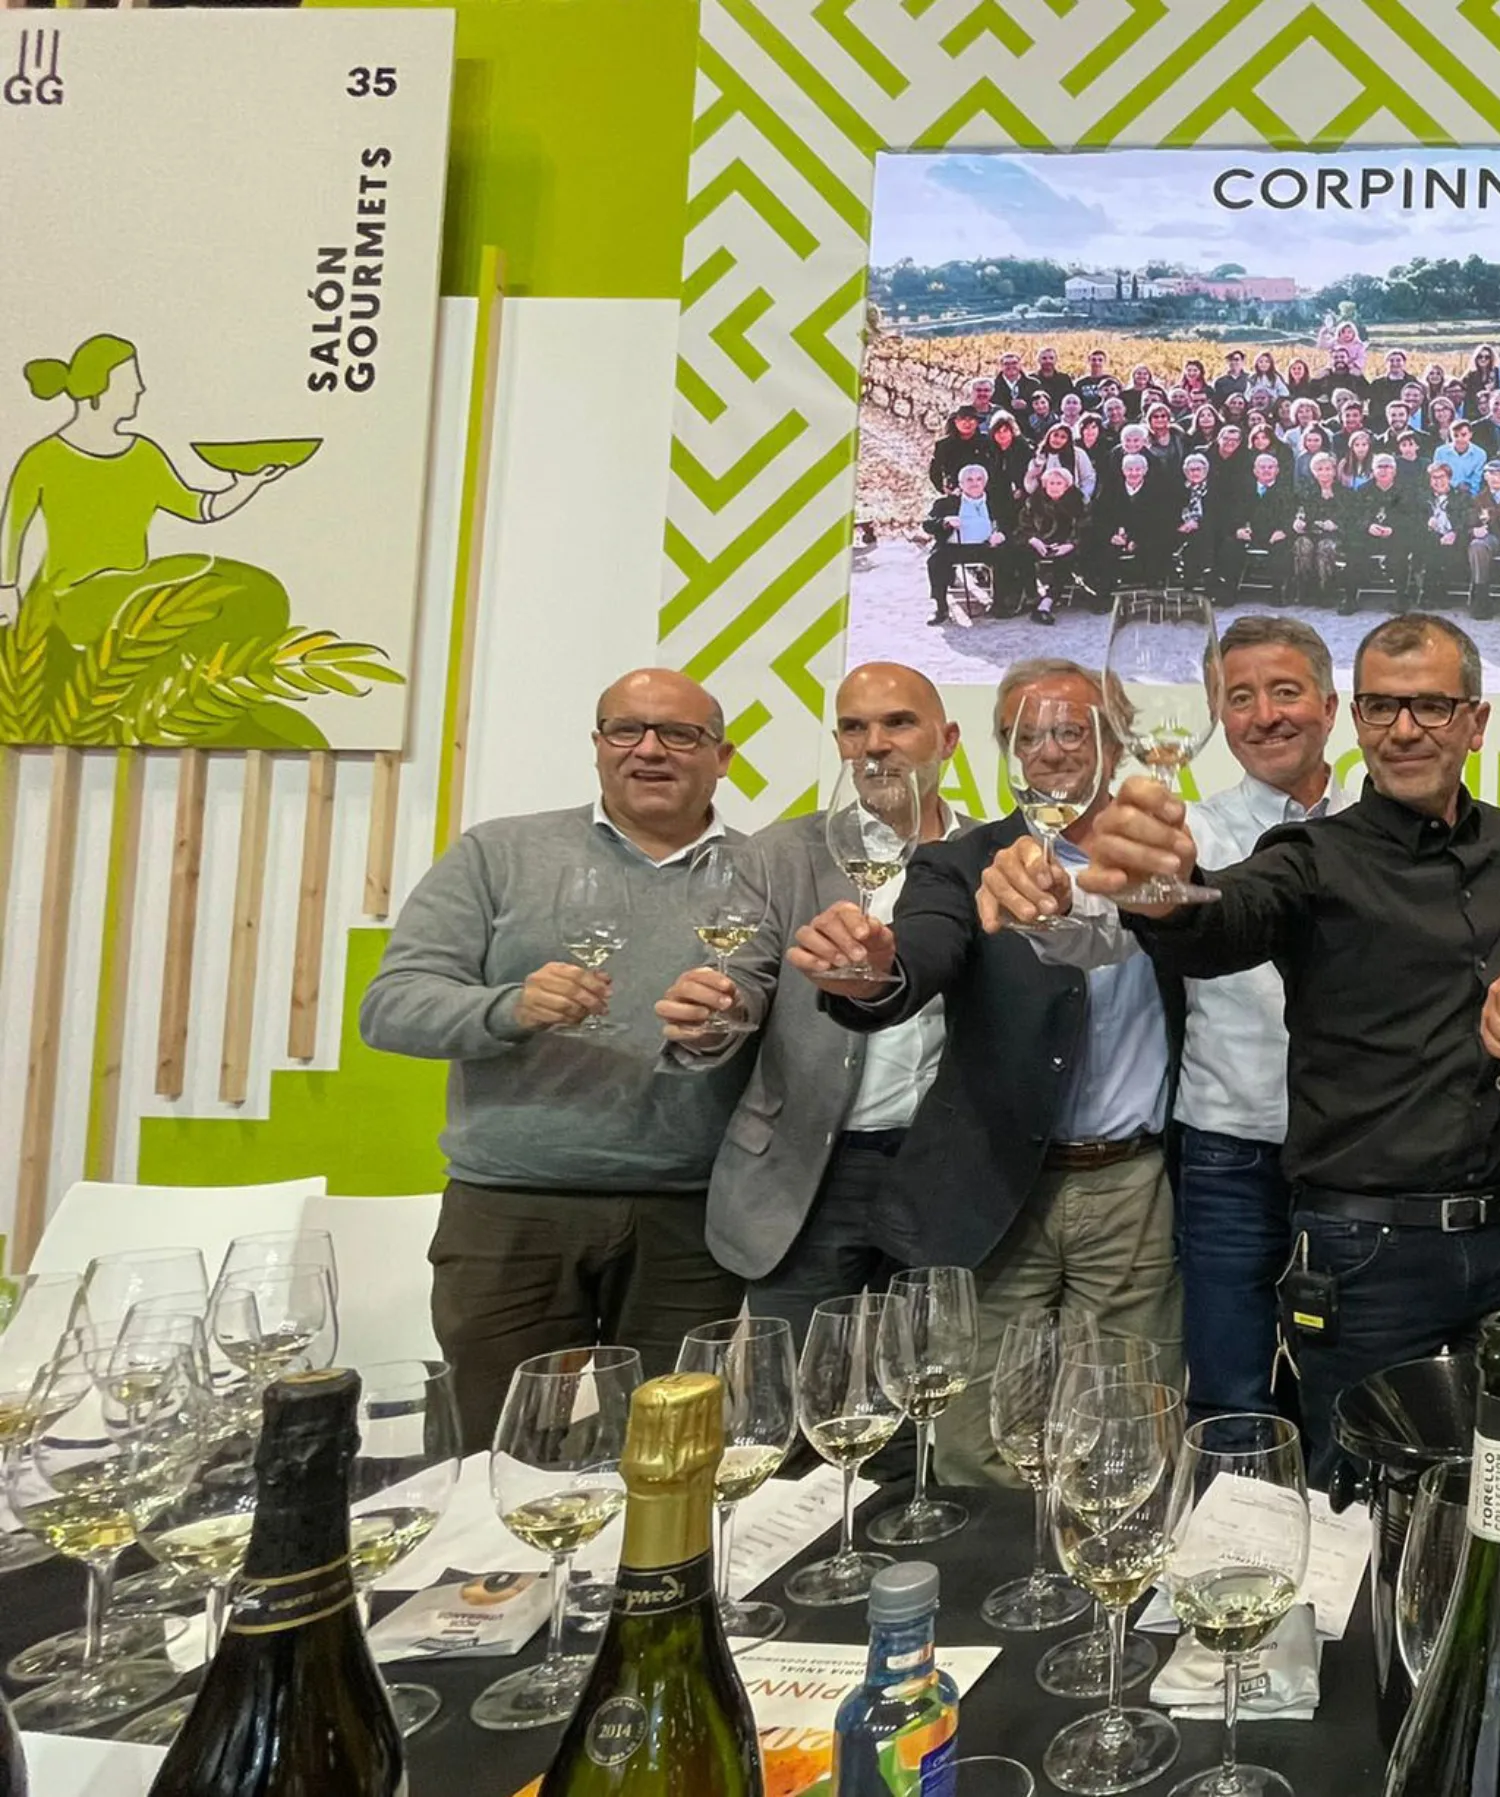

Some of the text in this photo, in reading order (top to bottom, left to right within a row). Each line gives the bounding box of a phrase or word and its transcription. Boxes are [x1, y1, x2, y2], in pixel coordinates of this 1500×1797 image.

[346, 67, 398, 98] 35
[345, 147, 392, 392] GOURMETS
[308, 247, 348, 392] SALÓN
[598, 1723, 632, 1739] 2014
